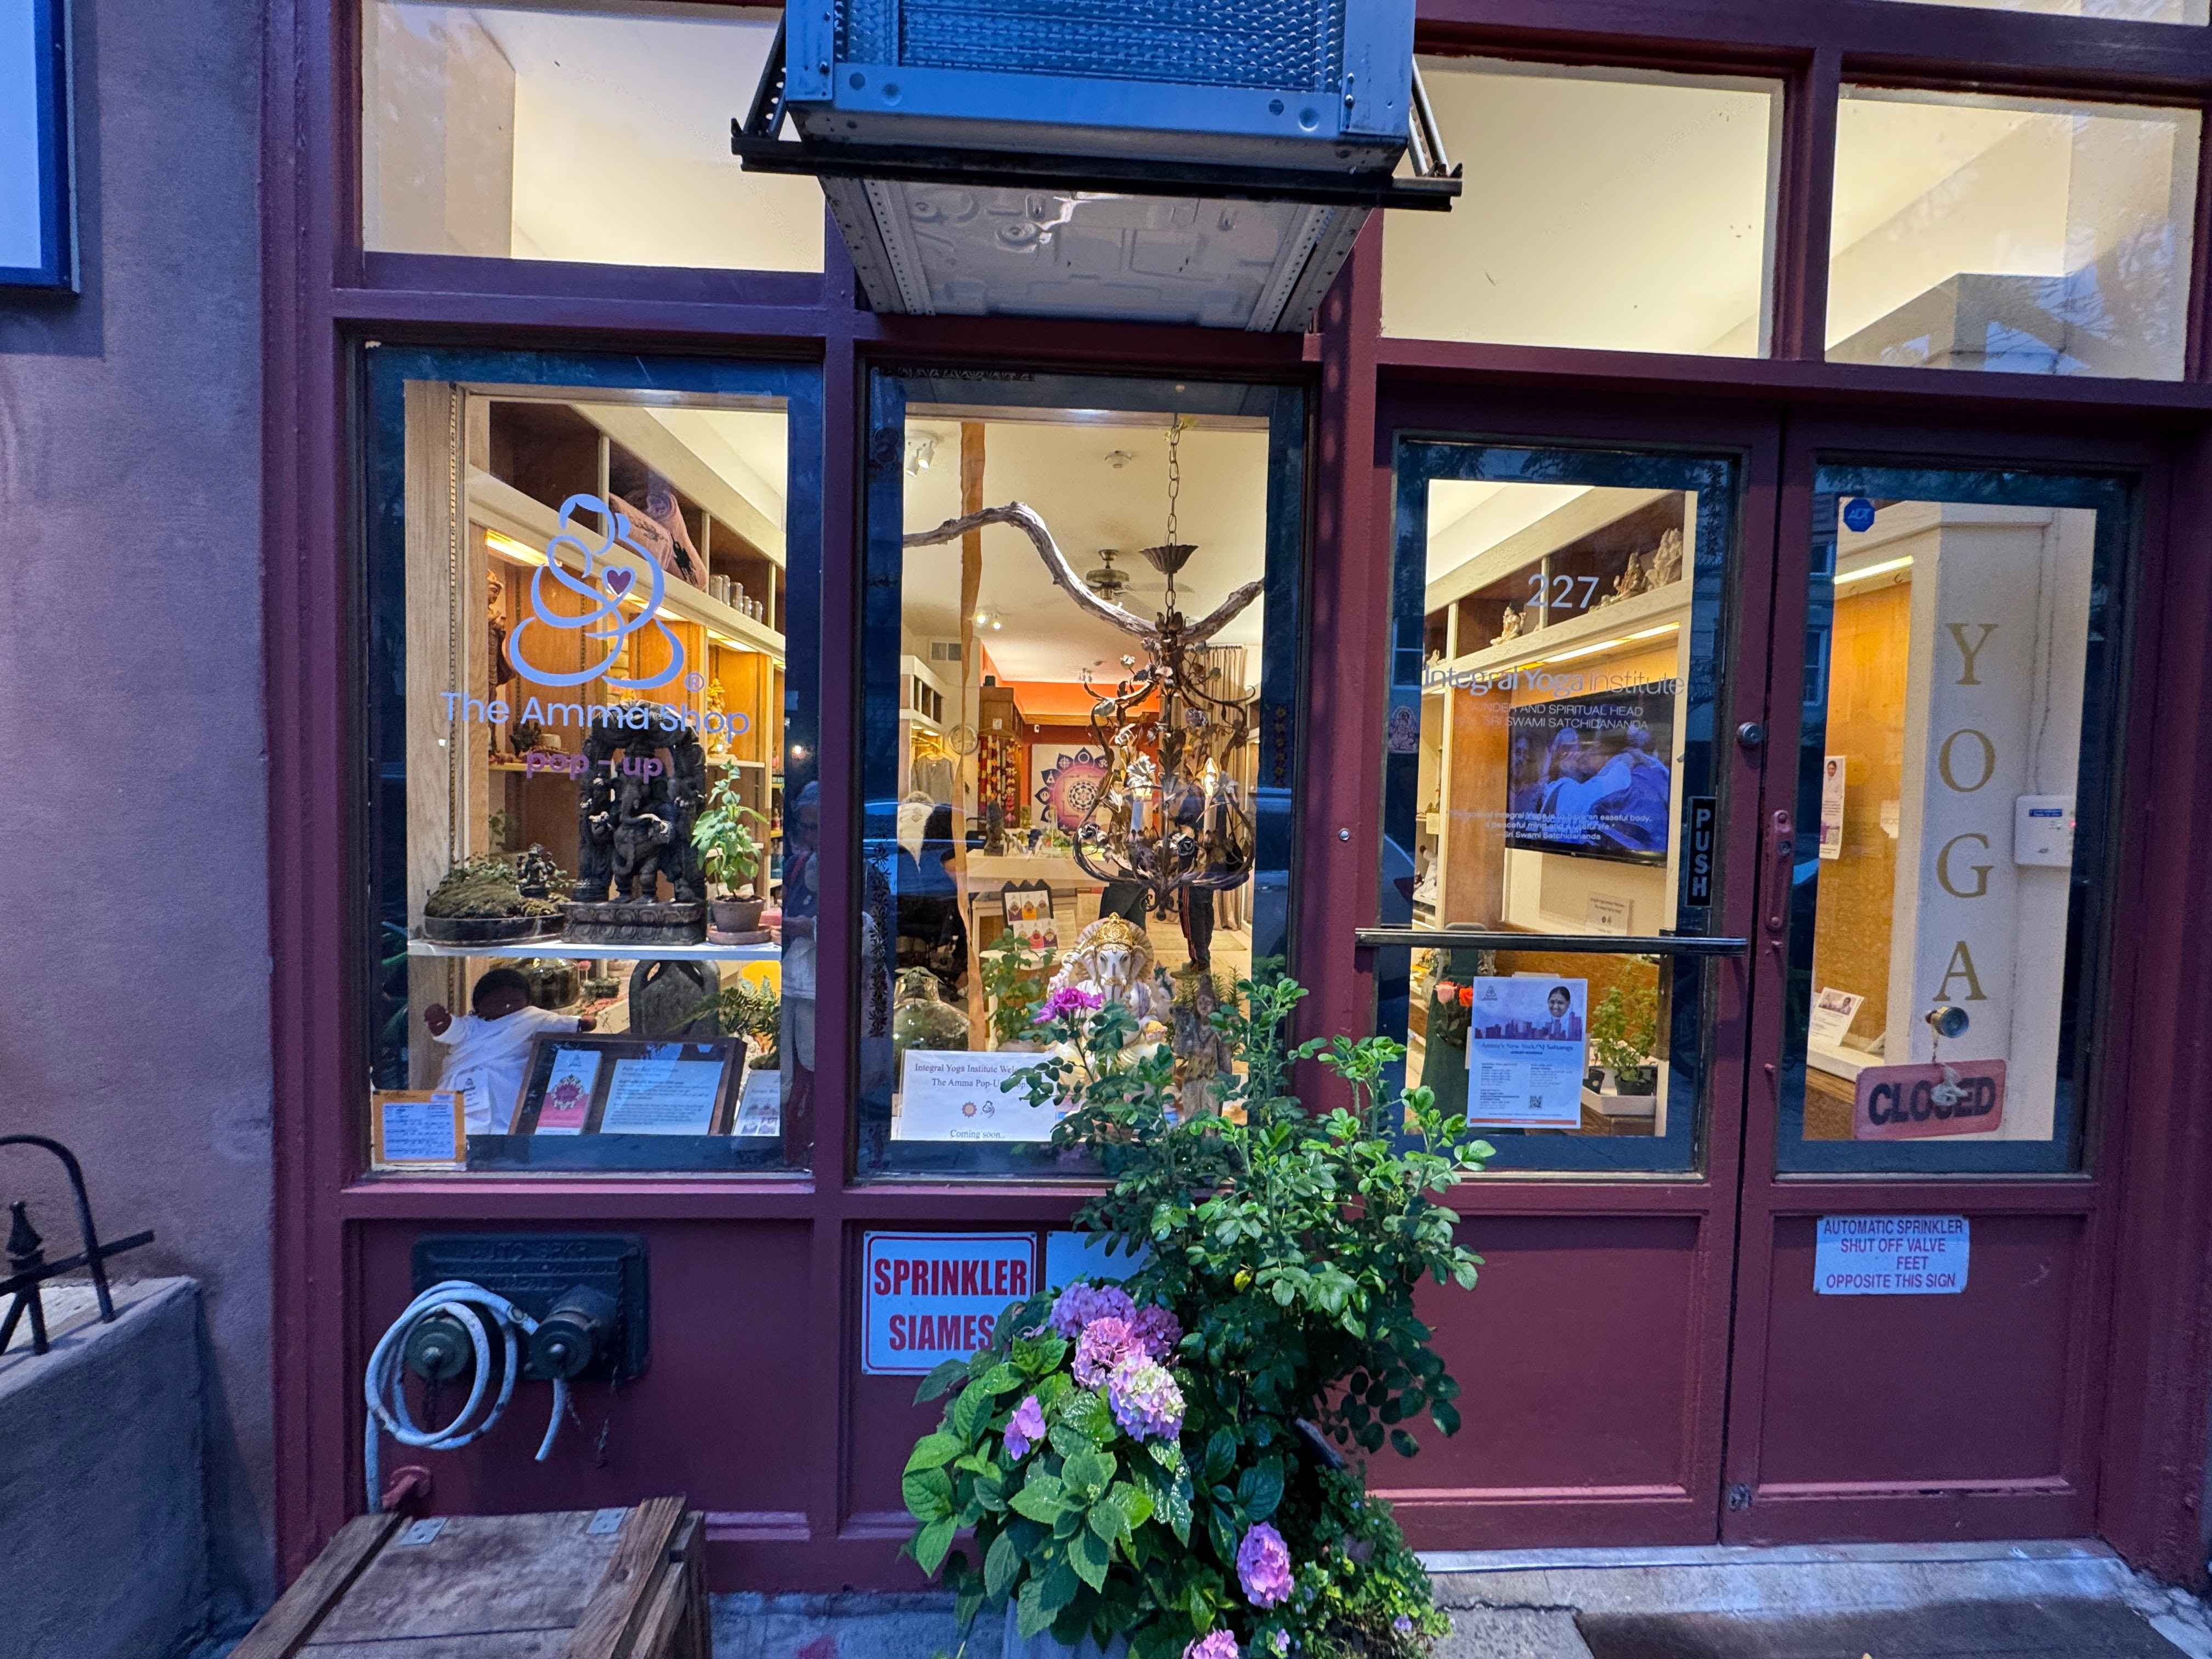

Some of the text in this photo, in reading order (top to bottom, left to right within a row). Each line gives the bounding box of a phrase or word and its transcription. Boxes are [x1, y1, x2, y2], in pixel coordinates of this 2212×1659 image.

[1527, 574, 1599, 608] 227
[1425, 664, 1684, 698] Integral Yoga Institute
[441, 691, 749, 742] The Amma Shop
[1520, 704, 1546, 714] AND
[1548, 704, 1607, 715] SPIRITUAL
[1610, 706, 1644, 716] HEAD
[1508, 716, 1545, 727] SWAMI
[1548, 717, 1649, 730] SATCHIDANANDA
[527, 752, 590, 781] pop
[623, 757, 663, 785] up
[1495, 811, 1524, 820] Integral
[1933, 623, 1999, 1001] YOGA
[1692, 808, 1711, 897] PUSH
[915, 1063, 944, 1073] Integral
[946, 1064, 966, 1074] Yoga
[967, 1064, 998, 1073] Institute
[932, 1078, 947, 1086] The
[975, 1079, 1001, 1089] Pop-U
[950, 1129, 980, 1139] Coming
[1824, 1219, 1963, 1234] AUTOMATIC SPRINKLER
[1841, 1237, 1946, 1253] SHUT OFF VALVE
[1896, 1255, 1929, 1271] FEET
[874, 1258, 1027, 1296] SPRINKLER
[1826, 1273, 1956, 1289] OPPOSITE THIS SIGN
[889, 1314, 1009, 1351] SIAMES
